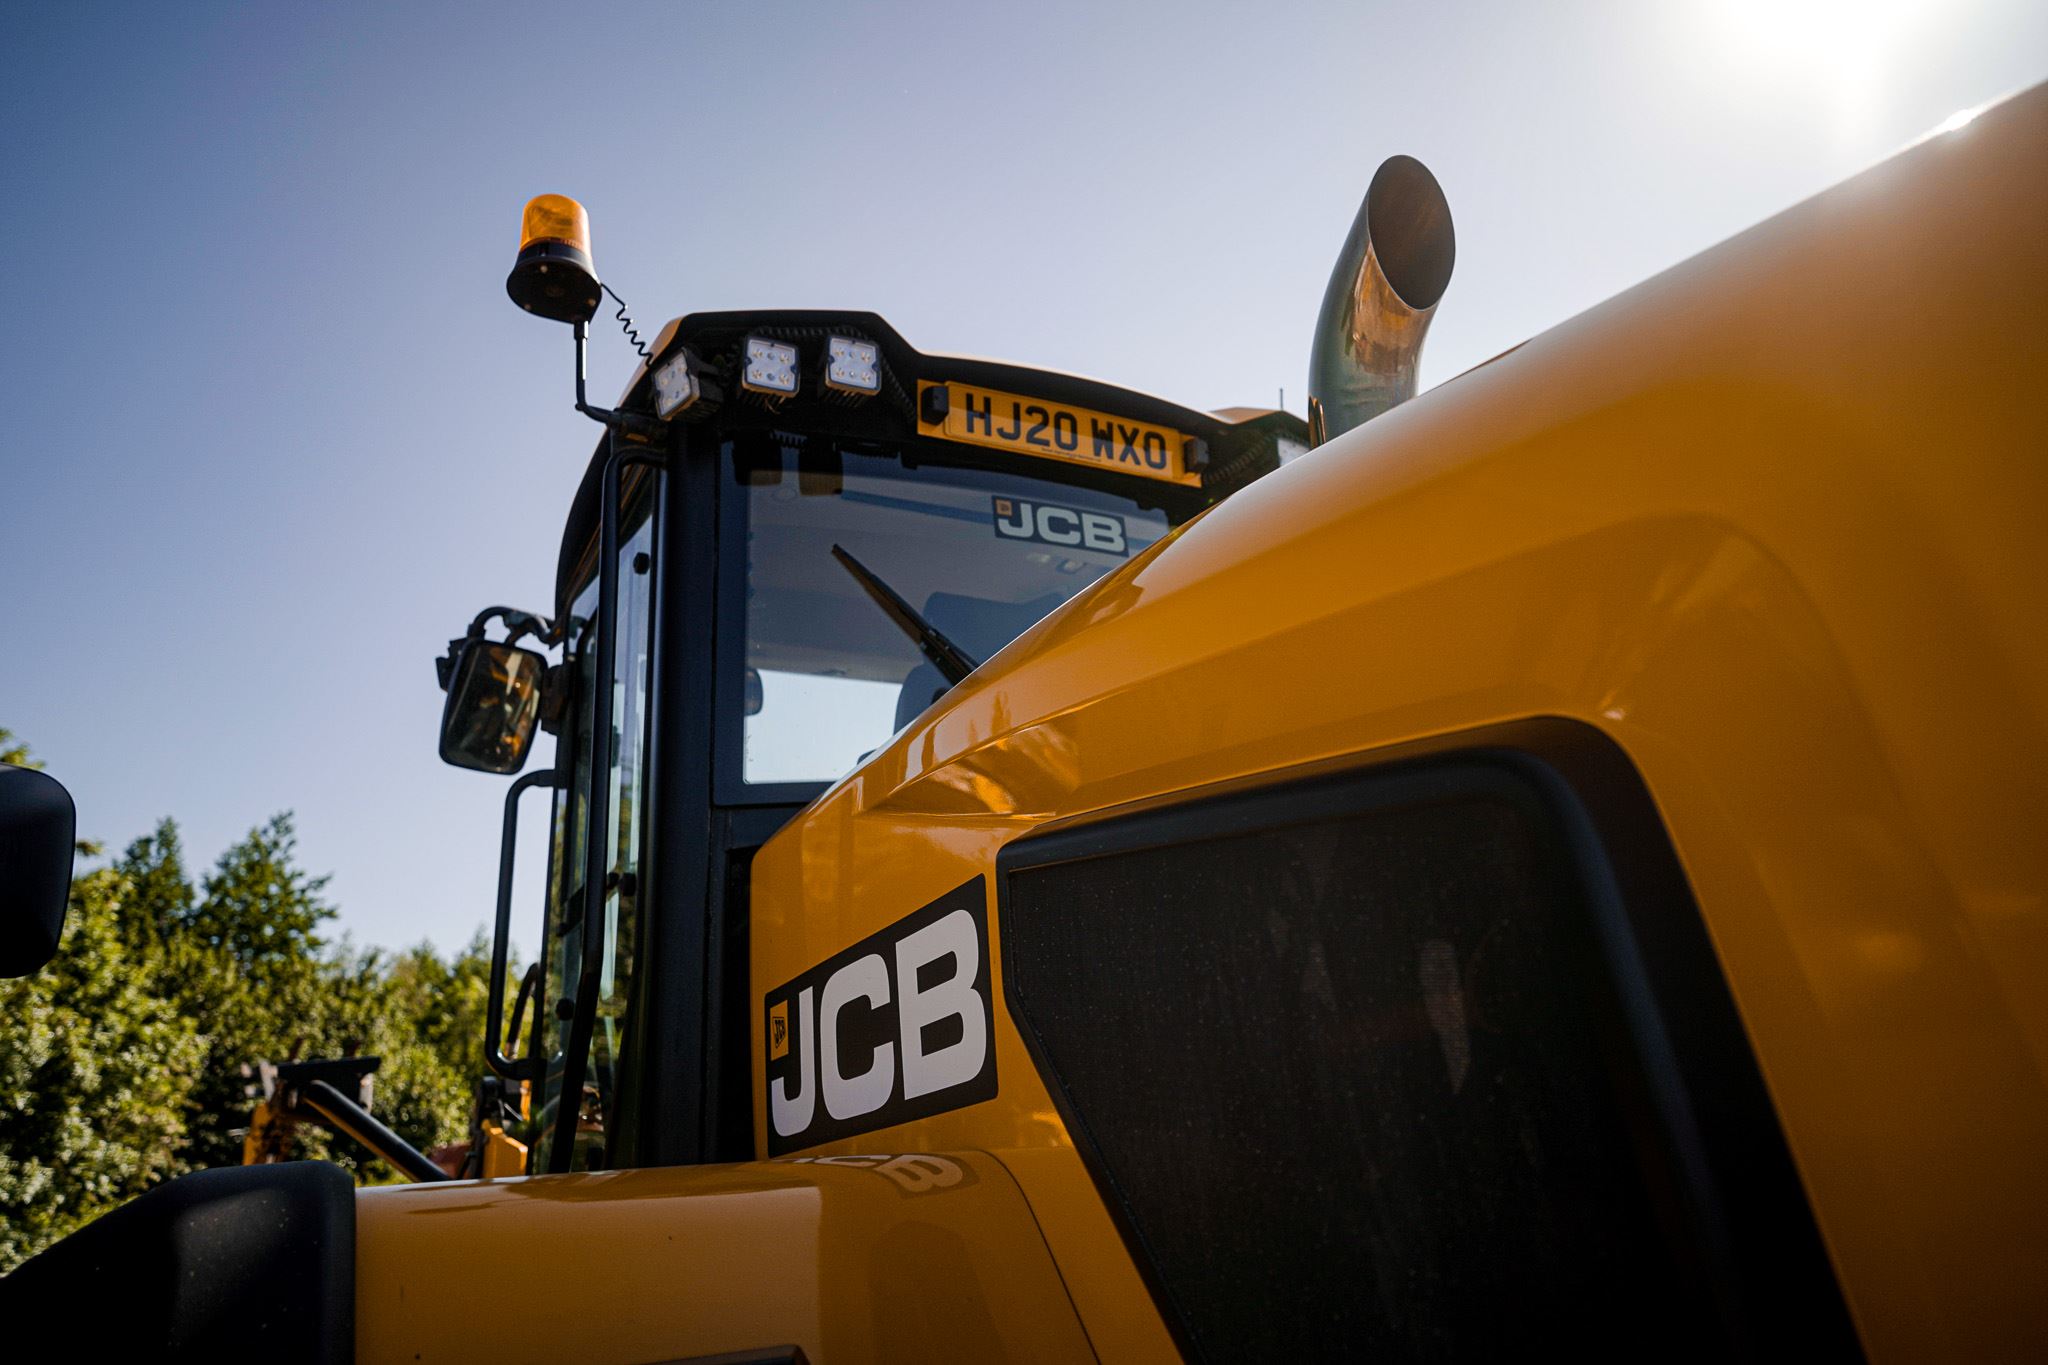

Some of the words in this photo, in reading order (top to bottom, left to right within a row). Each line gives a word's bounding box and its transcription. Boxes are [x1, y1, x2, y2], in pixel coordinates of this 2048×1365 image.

[966, 393, 1078, 451] HJ20
[1091, 418, 1167, 470] WXO
[998, 503, 1125, 553] JCB
[771, 909, 987, 1137] JCB
